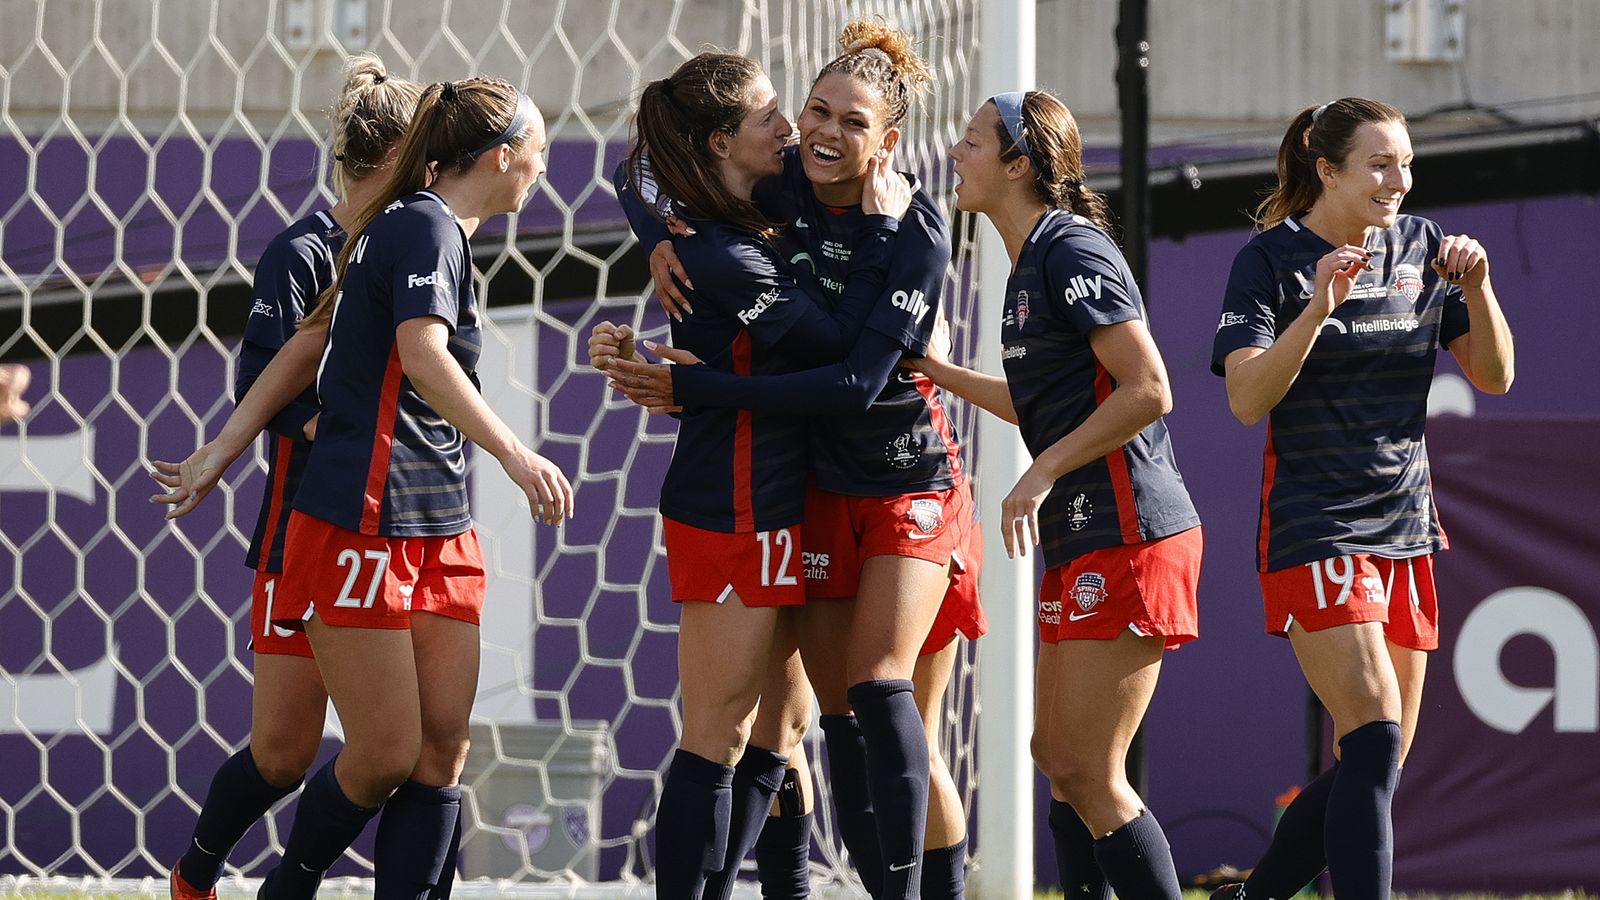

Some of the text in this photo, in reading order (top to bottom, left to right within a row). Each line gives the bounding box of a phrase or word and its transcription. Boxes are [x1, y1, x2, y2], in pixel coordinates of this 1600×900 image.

[737, 287, 781, 325] FedEx
[1064, 274, 1101, 305] ally
[892, 289, 930, 324] ally
[1352, 318, 1419, 333] IntelliBridge
[756, 528, 797, 586] 12
[801, 552, 829, 566] CVS
[333, 548, 389, 608] 27
[1077, 586, 1100, 594] SPIRIT
[1305, 555, 1354, 609] 19
[784, 781, 794, 790] KT
